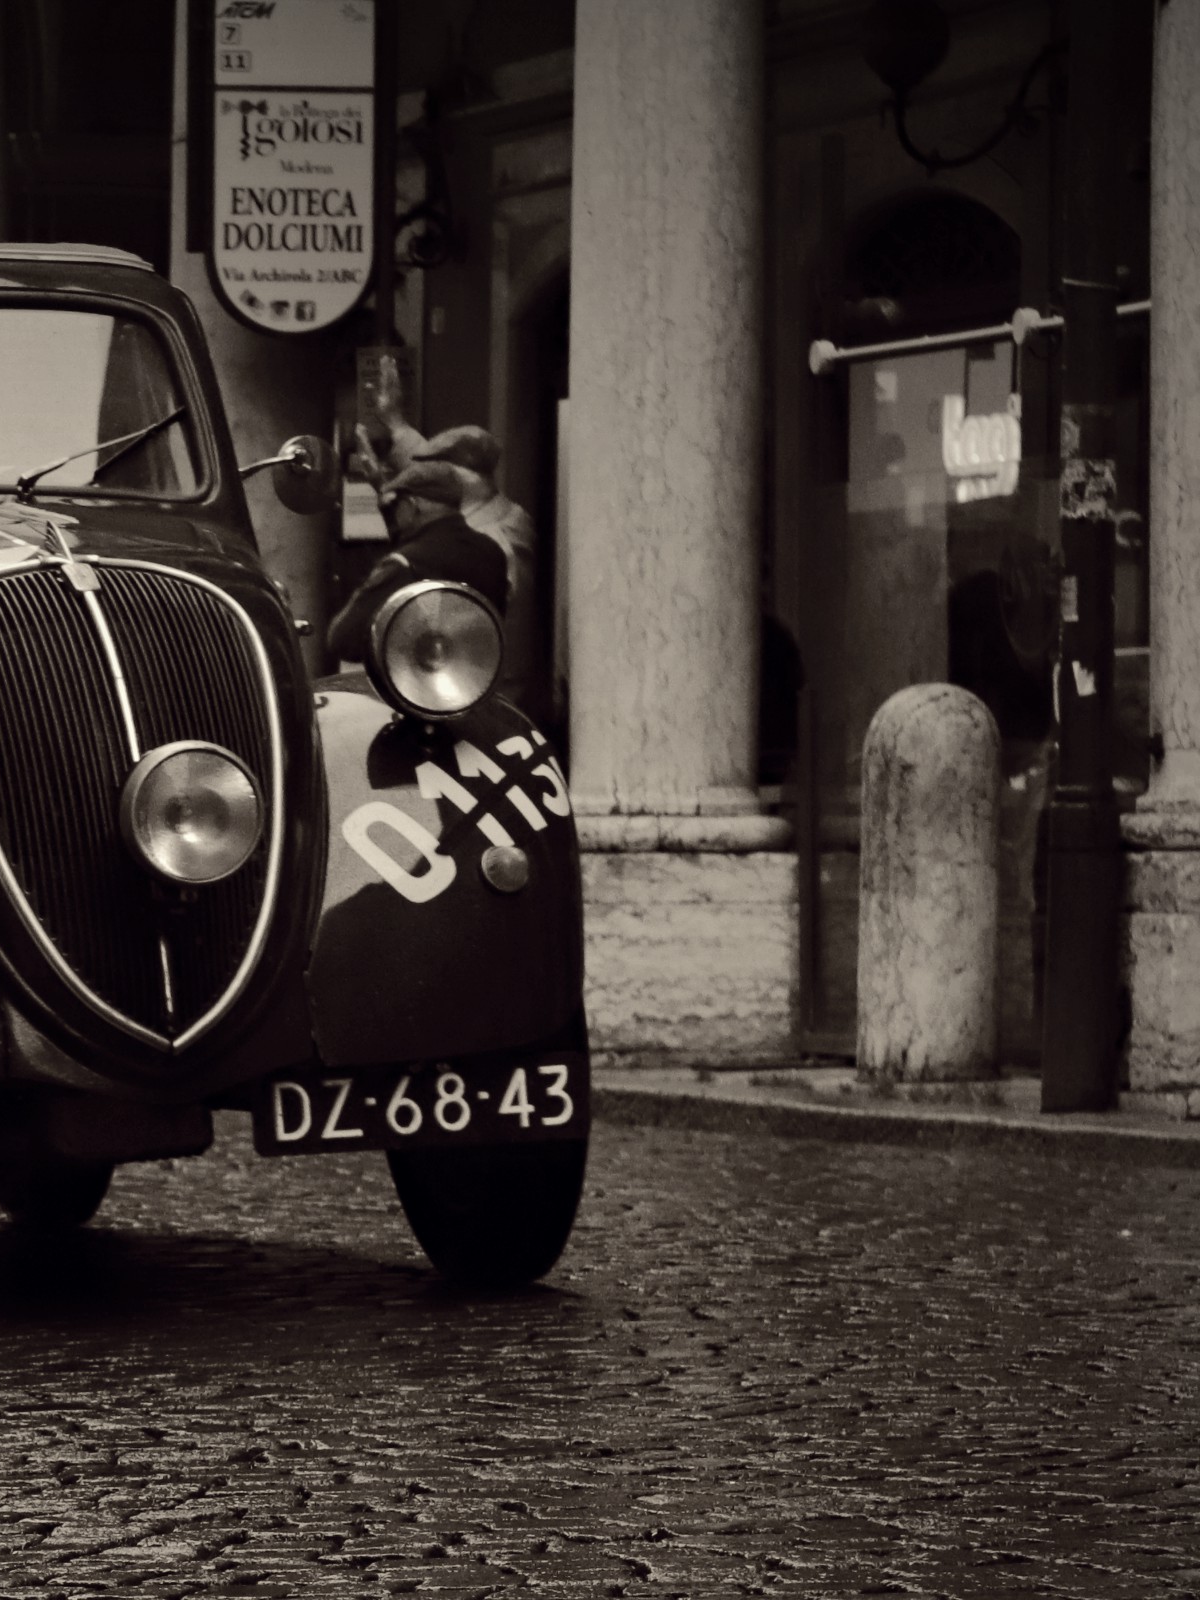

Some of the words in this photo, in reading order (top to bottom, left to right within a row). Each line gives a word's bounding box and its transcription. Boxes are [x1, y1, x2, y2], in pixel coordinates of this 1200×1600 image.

[225, 26, 236, 41] 7
[223, 55, 246, 69] 11
[230, 187, 358, 218] ENOTECA
[222, 222, 363, 252] DOLCIUMI
